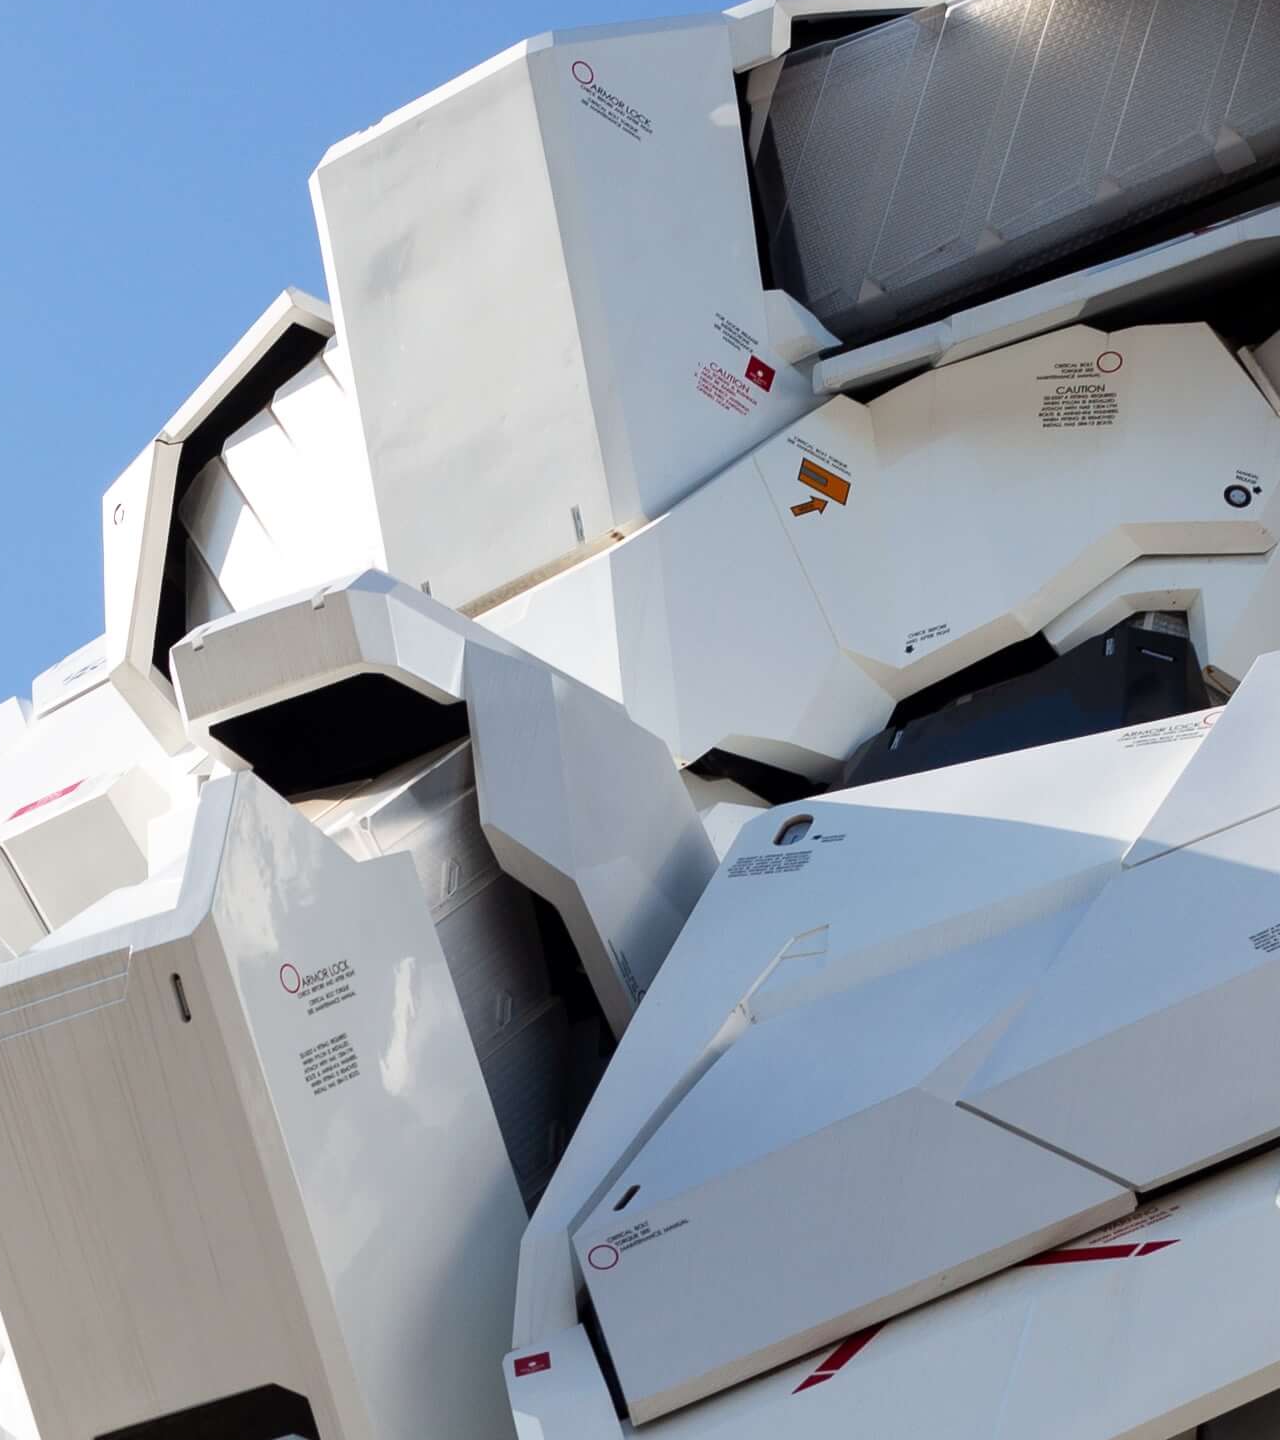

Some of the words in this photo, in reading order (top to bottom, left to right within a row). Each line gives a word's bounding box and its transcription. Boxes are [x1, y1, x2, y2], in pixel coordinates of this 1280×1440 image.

[709, 361, 750, 393] CAUTION
[1055, 383, 1105, 395] CAUTION
[301, 967, 329, 988] ARMOR
[327, 959, 349, 977] LOCK
